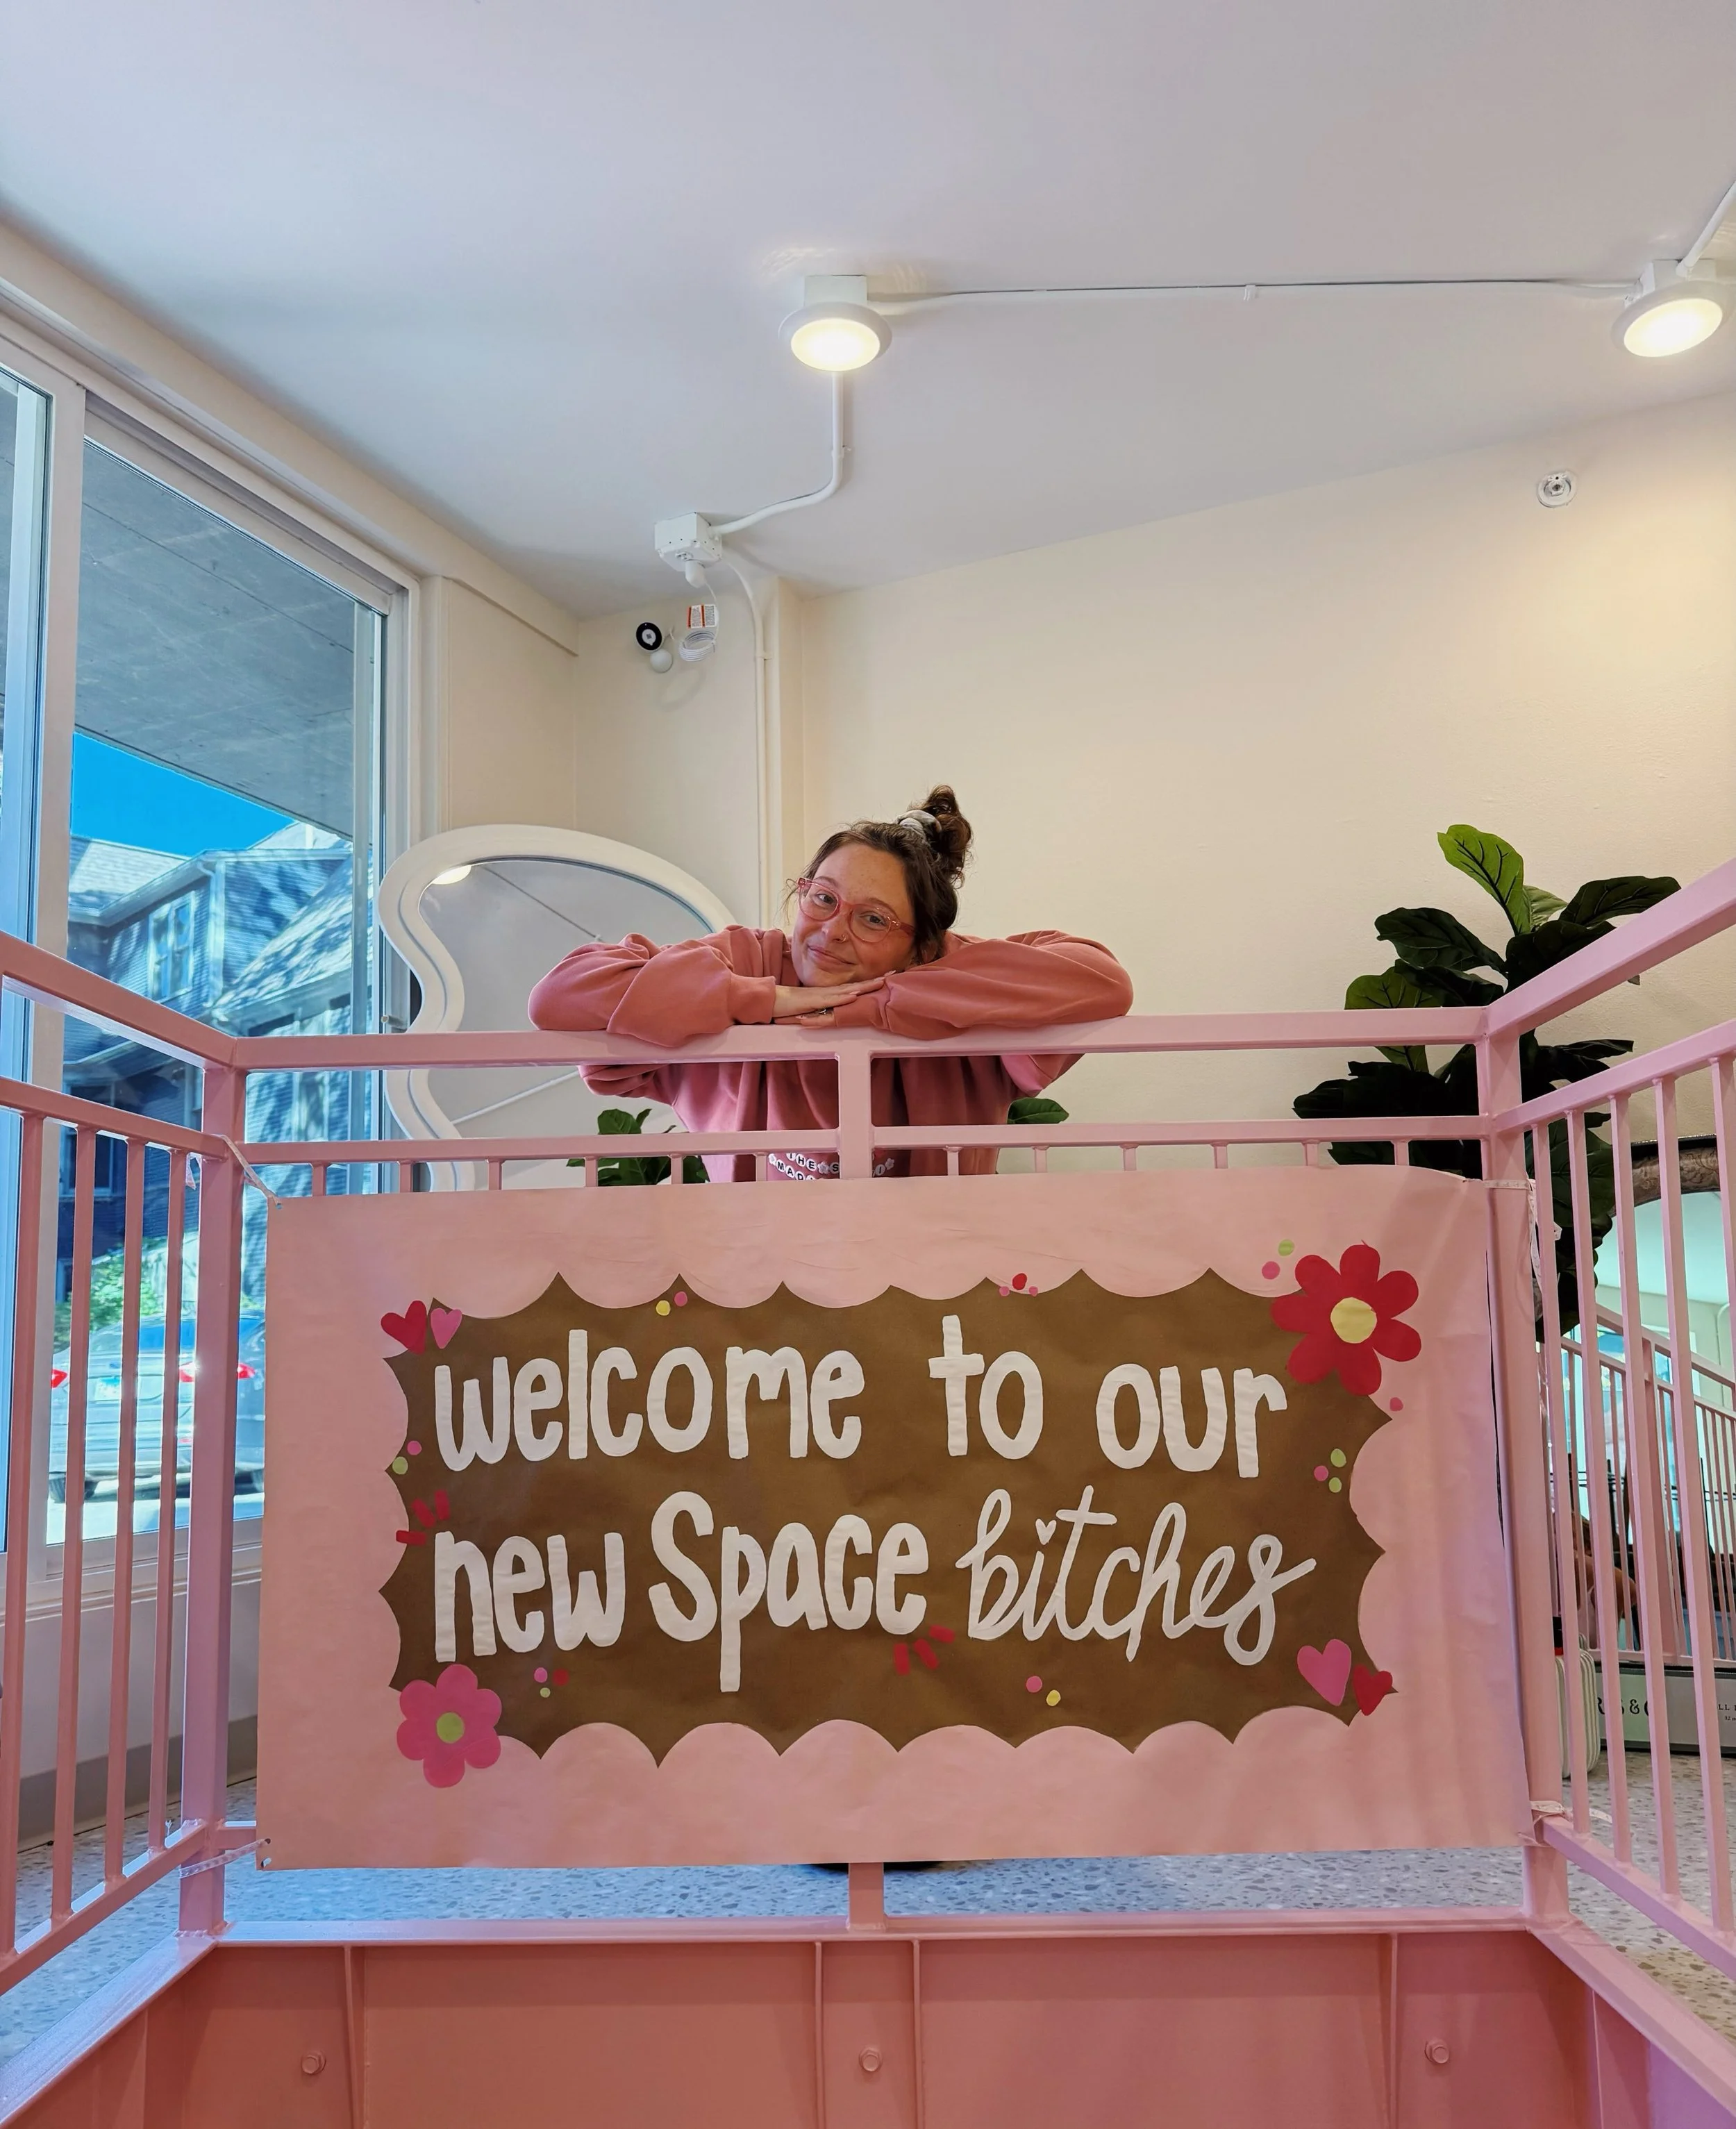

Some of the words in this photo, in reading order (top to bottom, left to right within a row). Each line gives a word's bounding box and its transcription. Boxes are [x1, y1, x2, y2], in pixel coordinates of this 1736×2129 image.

[435, 1329, 865, 1471] welcome
[929, 1314, 1044, 1460] to
[1096, 1363, 1287, 1478] our
[435, 1532, 626, 1662] new
[649, 1491, 929, 1693] Space
[955, 1485, 1317, 1666] bitches
